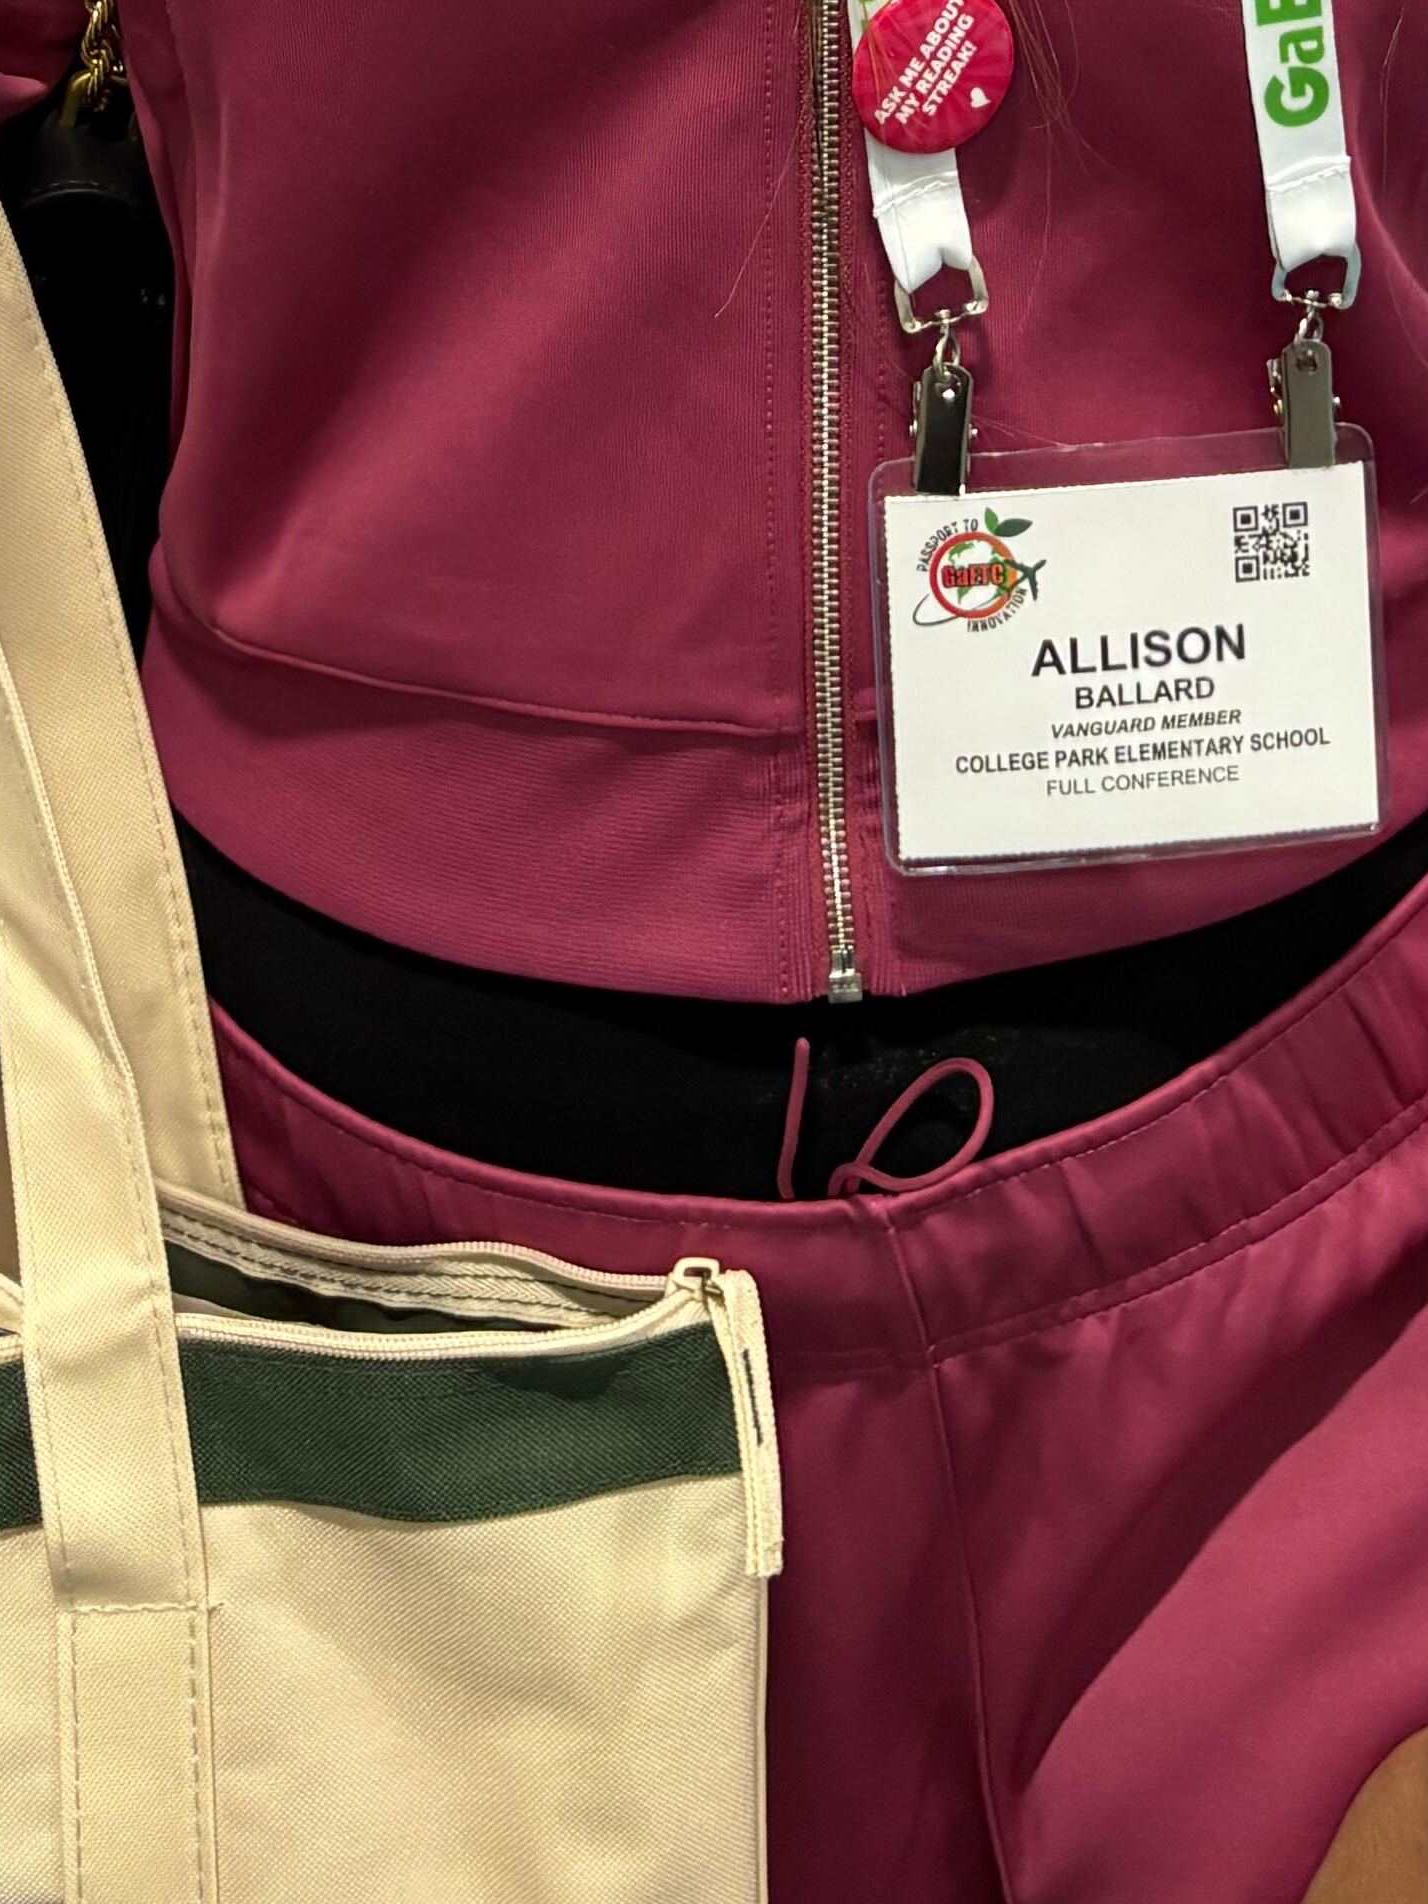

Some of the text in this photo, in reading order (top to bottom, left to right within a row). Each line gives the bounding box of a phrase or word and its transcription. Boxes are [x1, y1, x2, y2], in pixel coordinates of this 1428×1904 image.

[874, 86, 907, 125] ASK
[899, 56, 925, 88] ME
[894, 13, 975, 125] MY READING
[922, 40, 978, 116] STREAK!
[916, 518, 979, 573] PASSPORT TO
[967, 587, 1028, 633] INNOVATION
[1030, 623, 1246, 678] ALLISON
[1073, 675, 1216, 710] BALLARD
[1050, 708, 1242, 740] VANGUARD MEMBER
[954, 726, 1332, 775] COLLEGE PARK ELEMENTARY SCHOOL
[1045, 764, 1241, 797] FULL CONFERENCE
